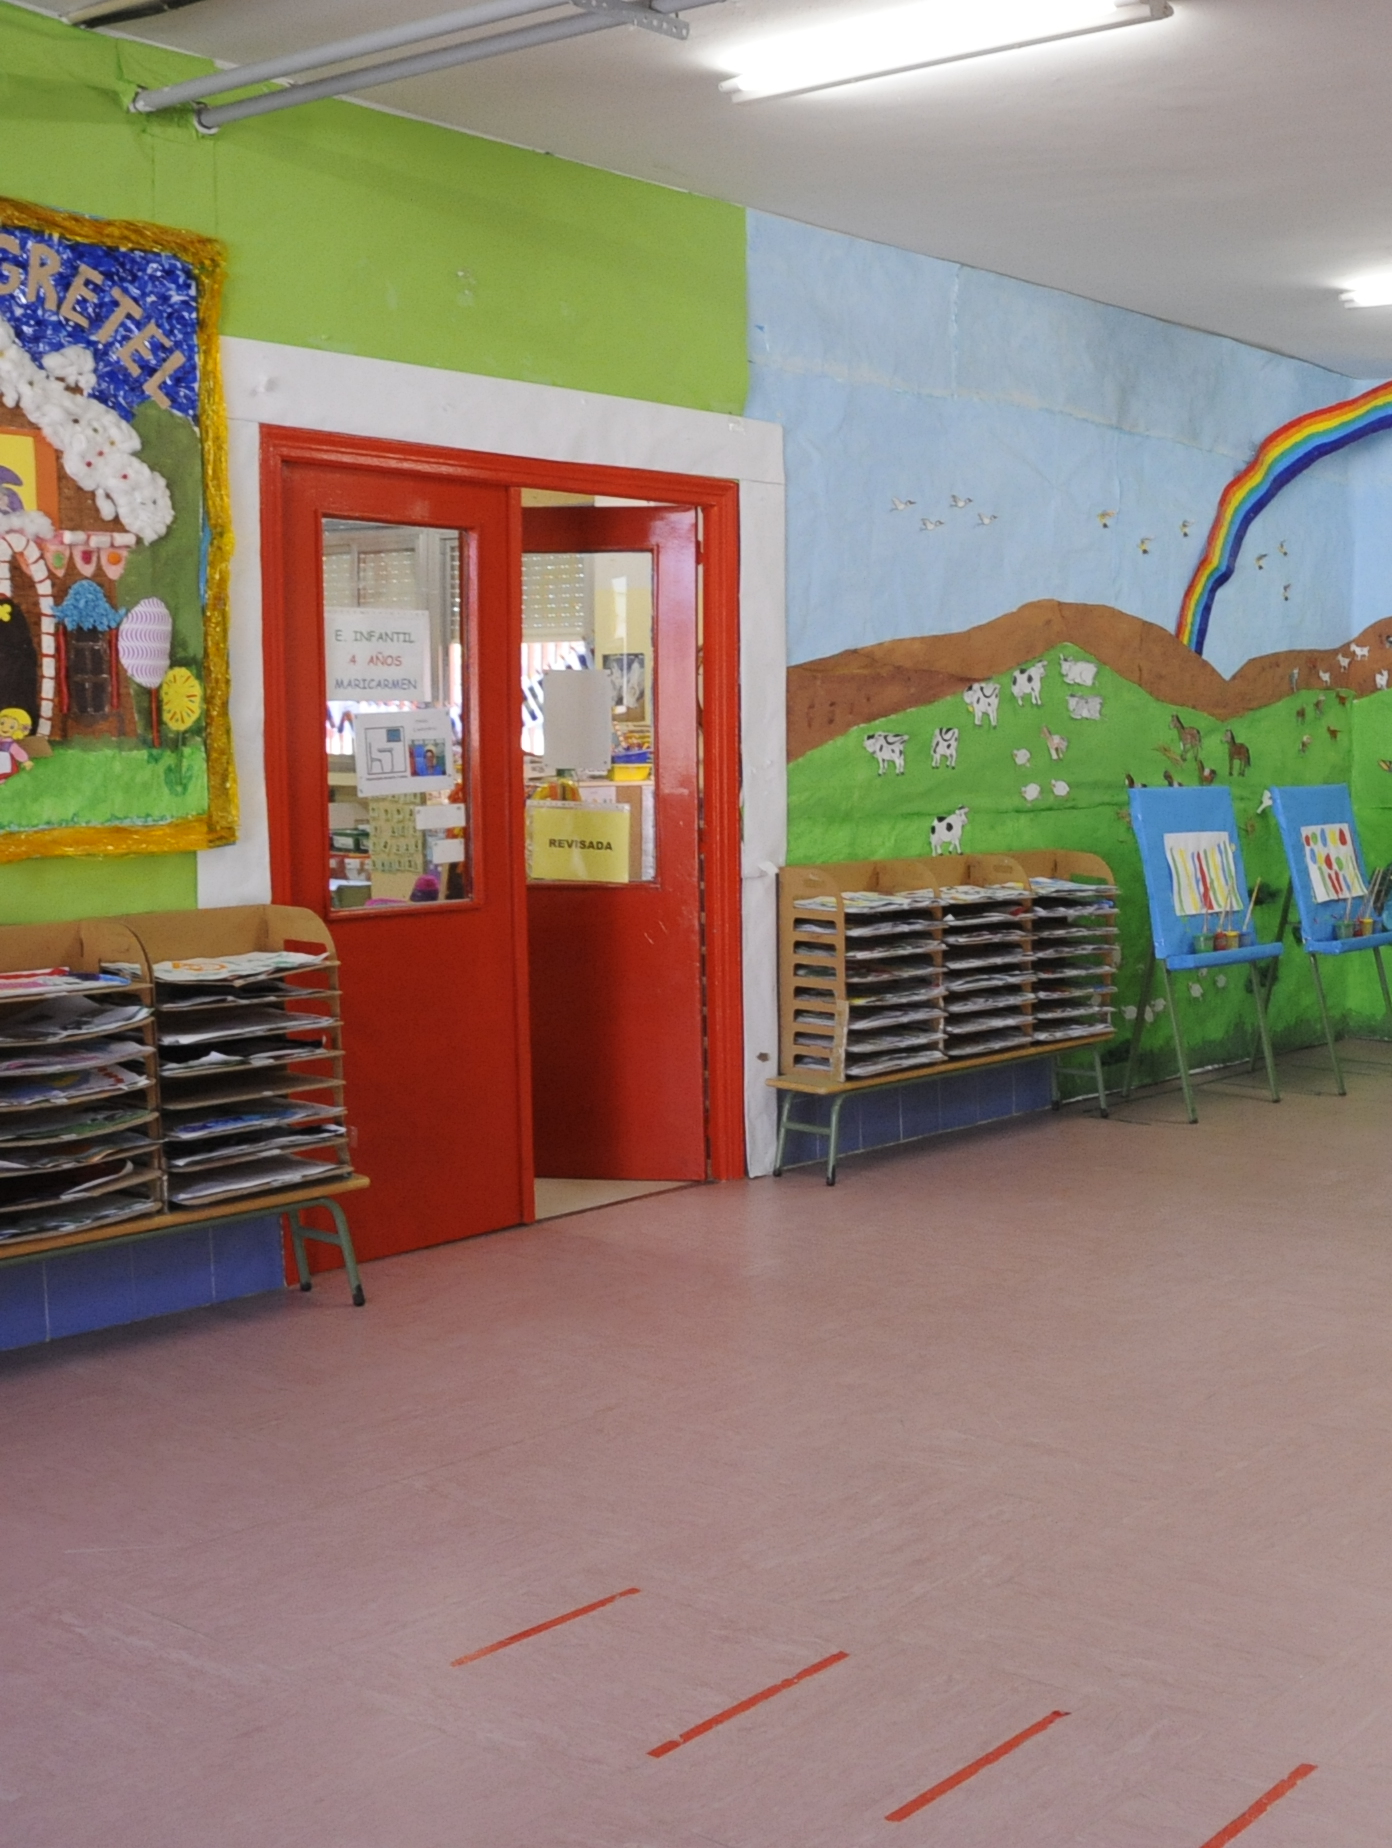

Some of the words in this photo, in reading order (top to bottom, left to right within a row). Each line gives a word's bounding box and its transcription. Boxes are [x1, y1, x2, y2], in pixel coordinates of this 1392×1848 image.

[334, 629, 347, 643] E.
[353, 630, 416, 644] INFANTIL
[348, 654, 357, 666] 4
[367, 651, 403, 667] AÑOS
[334, 678, 418, 691] MARICARMEN
[548, 838, 613, 851] REVISADA
